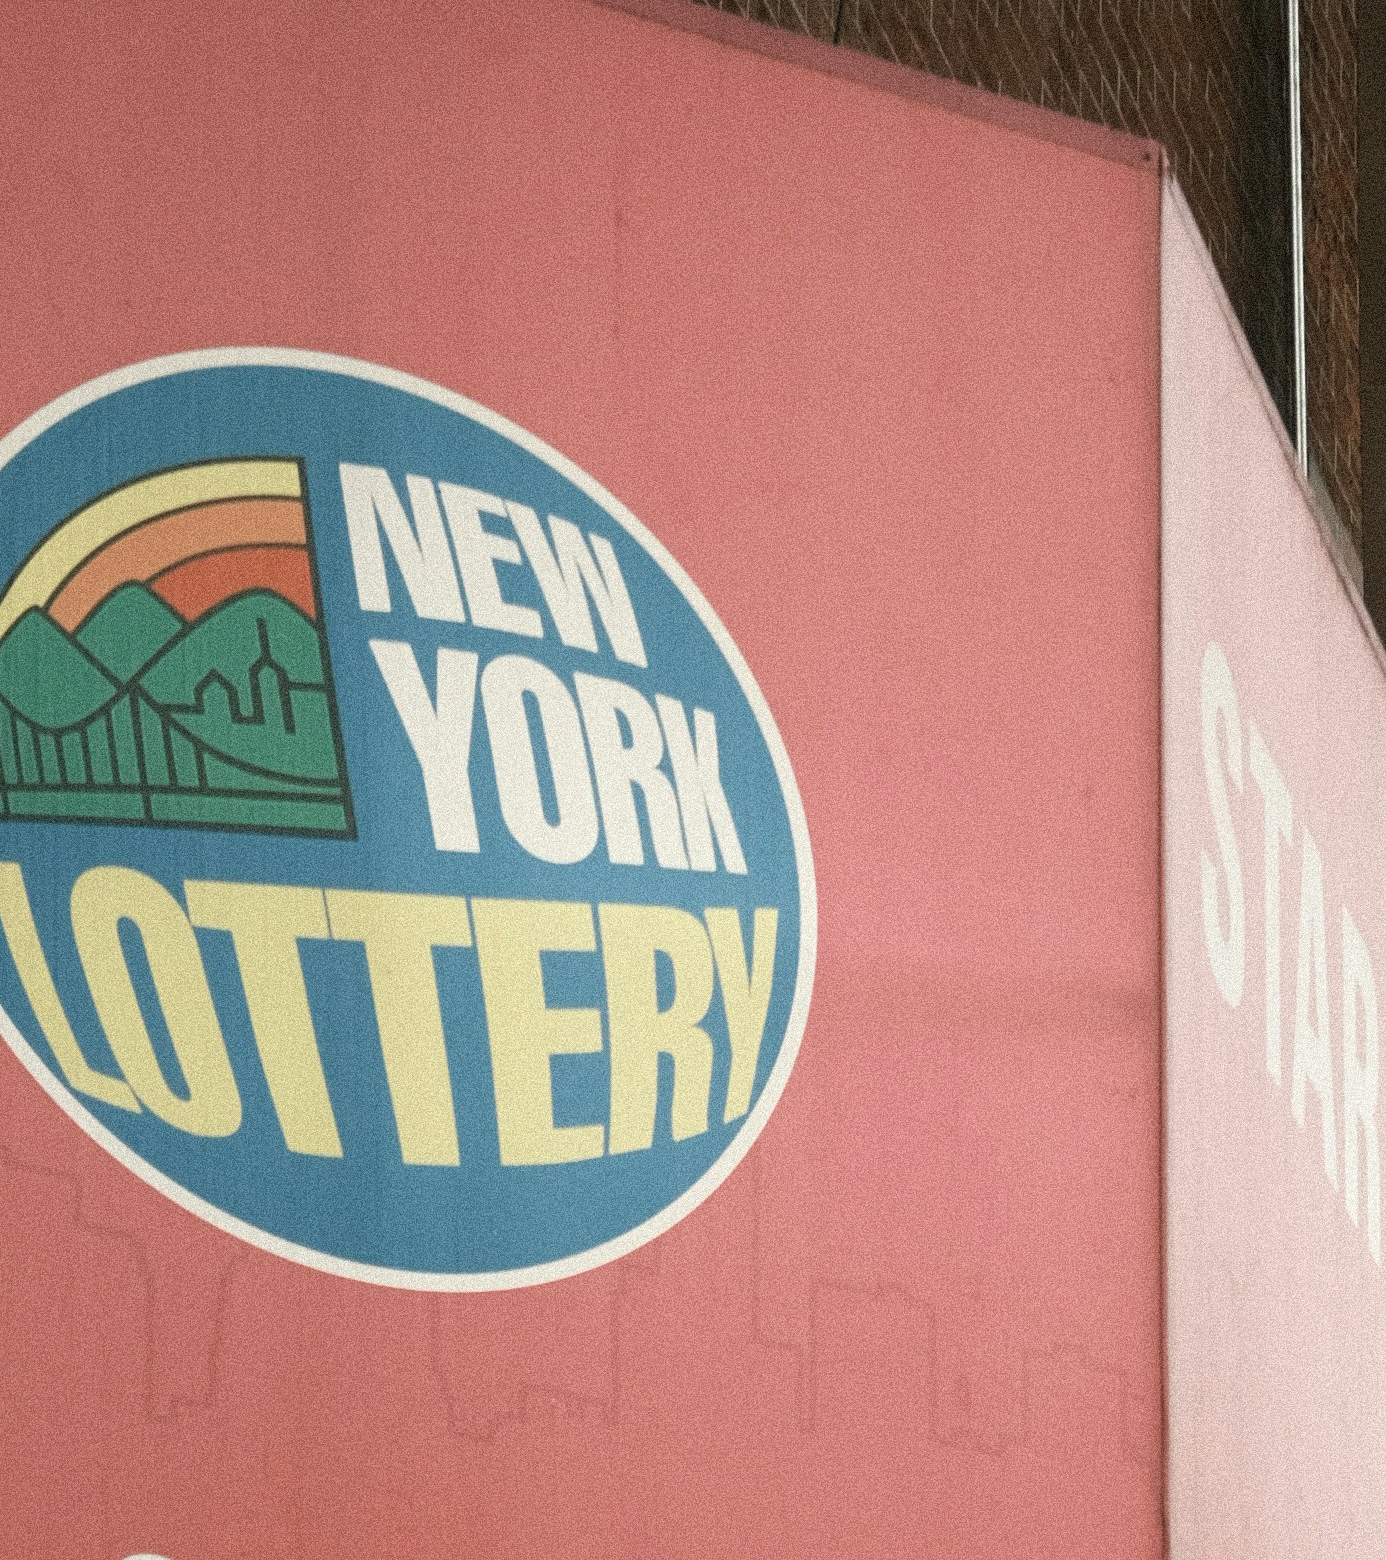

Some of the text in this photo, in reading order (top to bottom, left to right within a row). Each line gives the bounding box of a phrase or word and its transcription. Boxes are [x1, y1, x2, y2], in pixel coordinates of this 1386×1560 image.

[337, 461, 647, 668] NEW
[367, 638, 748, 876] YORK
[1200, 639, 1382, 1272] STAR
